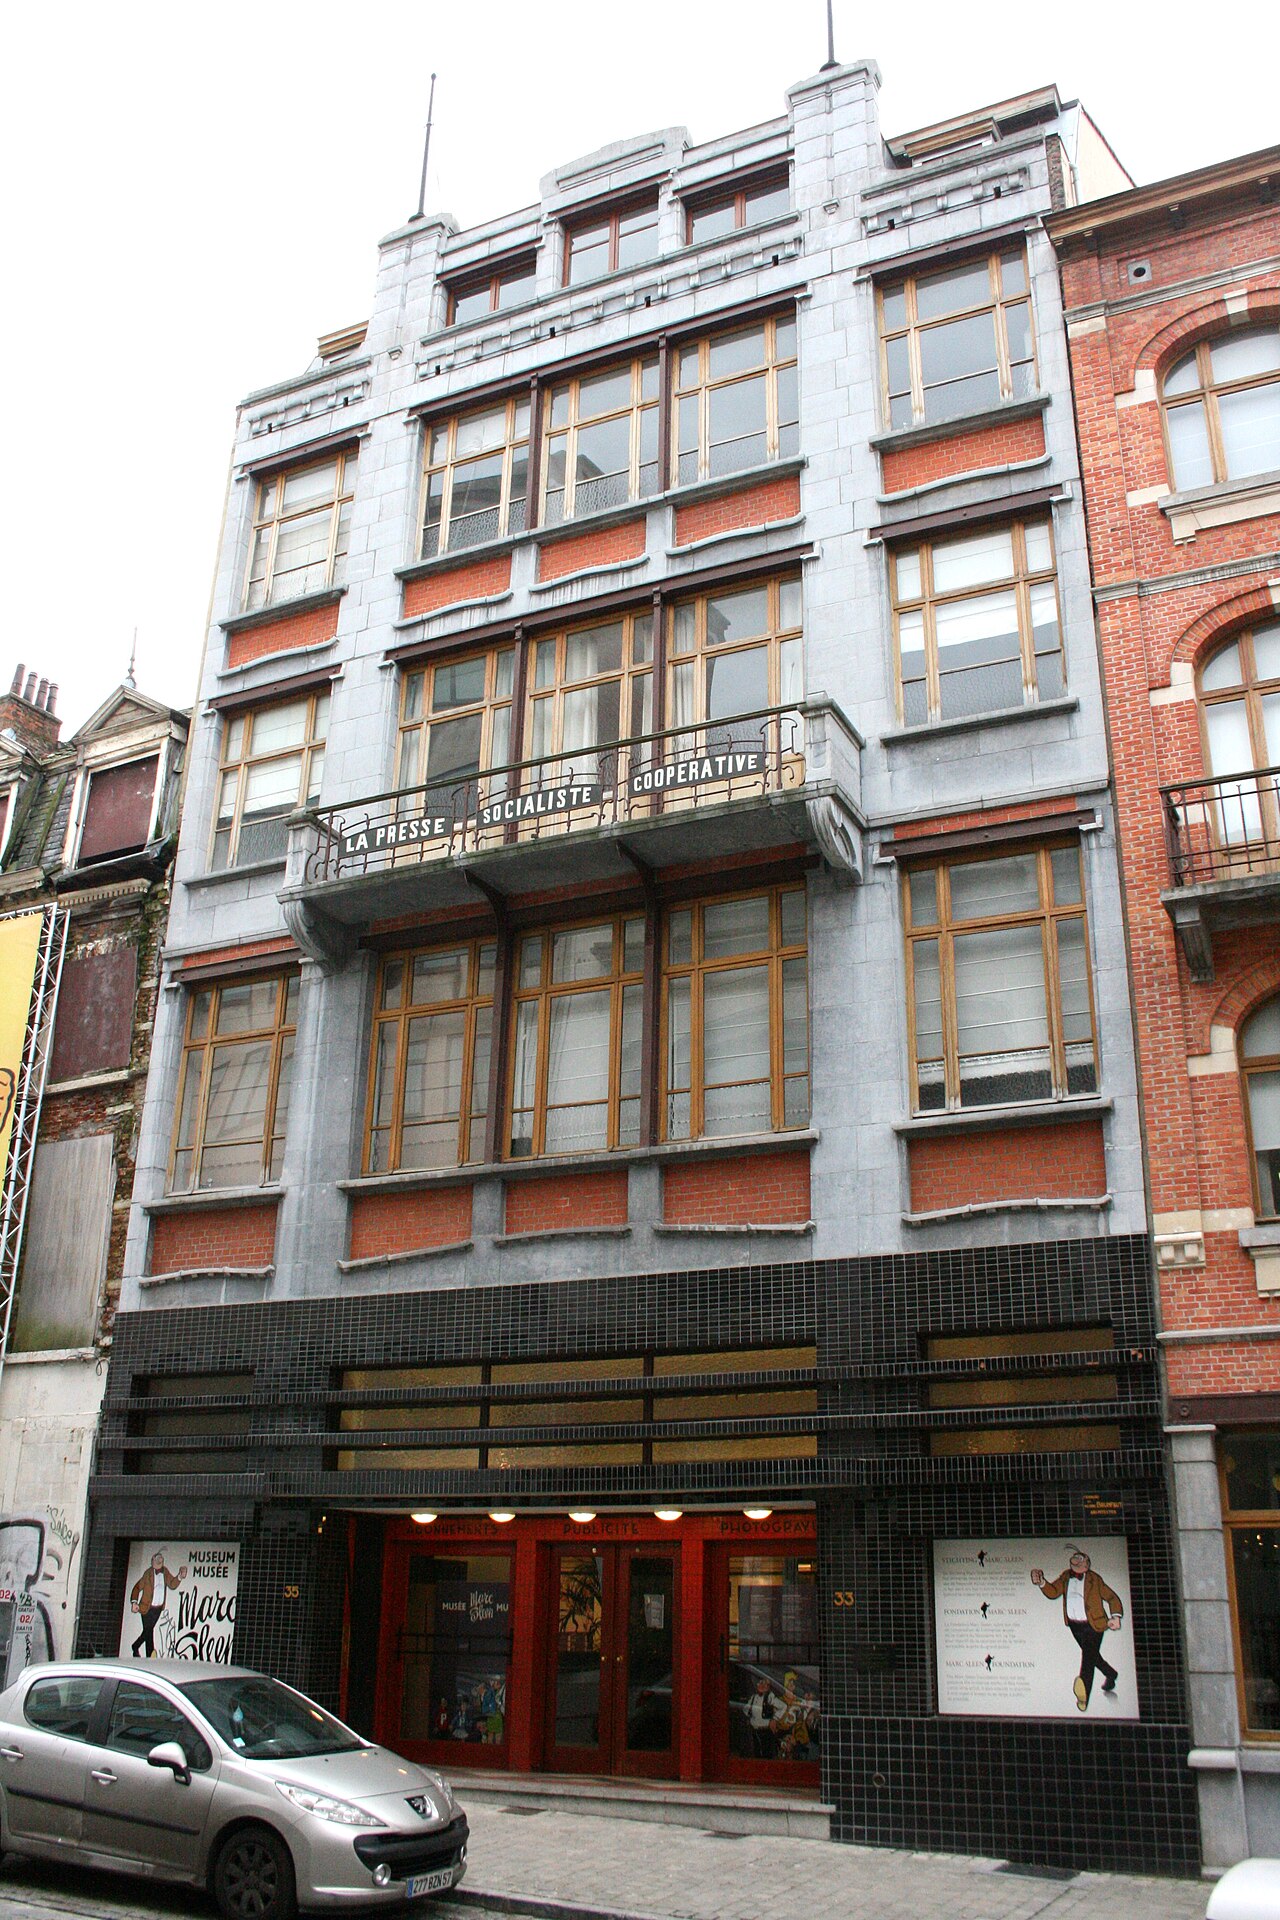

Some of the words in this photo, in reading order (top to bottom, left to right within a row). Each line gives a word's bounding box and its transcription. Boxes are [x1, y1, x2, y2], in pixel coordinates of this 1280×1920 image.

[633, 754, 758, 792] COOPERATIVE
[483, 786, 592, 824] SOCIALISTE
[346, 833, 369, 853] LA
[375, 817, 446, 847] PRESSE
[189, 1551, 236, 1563] MUSEUM
[193, 1564, 229, 1578] MUSÉE
[284, 1585, 299, 1598] 35
[834, 1591, 854, 1606] 33
[178, 1586, 237, 1632] Marc
[413, 1879, 428, 1894] 277
[443, 1871, 452, 1886] 57
